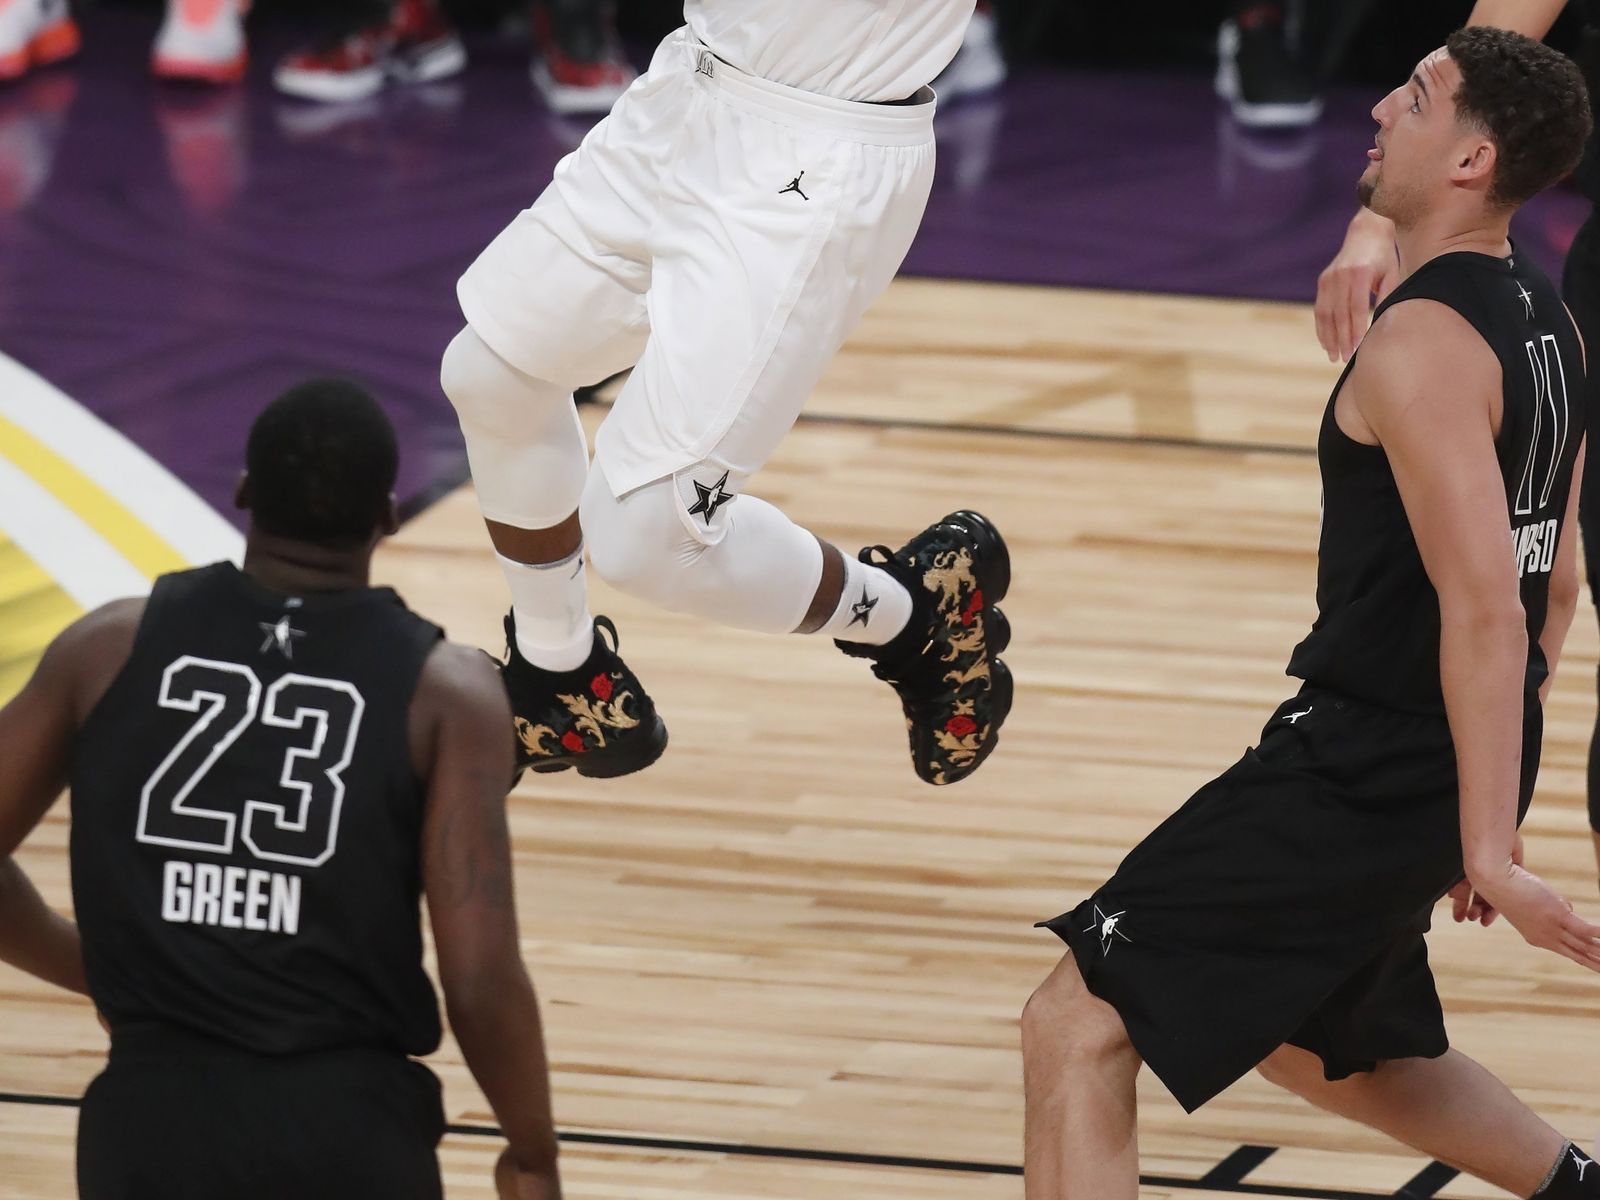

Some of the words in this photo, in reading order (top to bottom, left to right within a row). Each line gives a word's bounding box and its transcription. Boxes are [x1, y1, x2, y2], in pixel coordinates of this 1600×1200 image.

[1514, 333, 1570, 516] 11
[1511, 518, 1558, 579] MPSO
[135, 654, 366, 868] 23
[161, 860, 301, 936] GREEN
